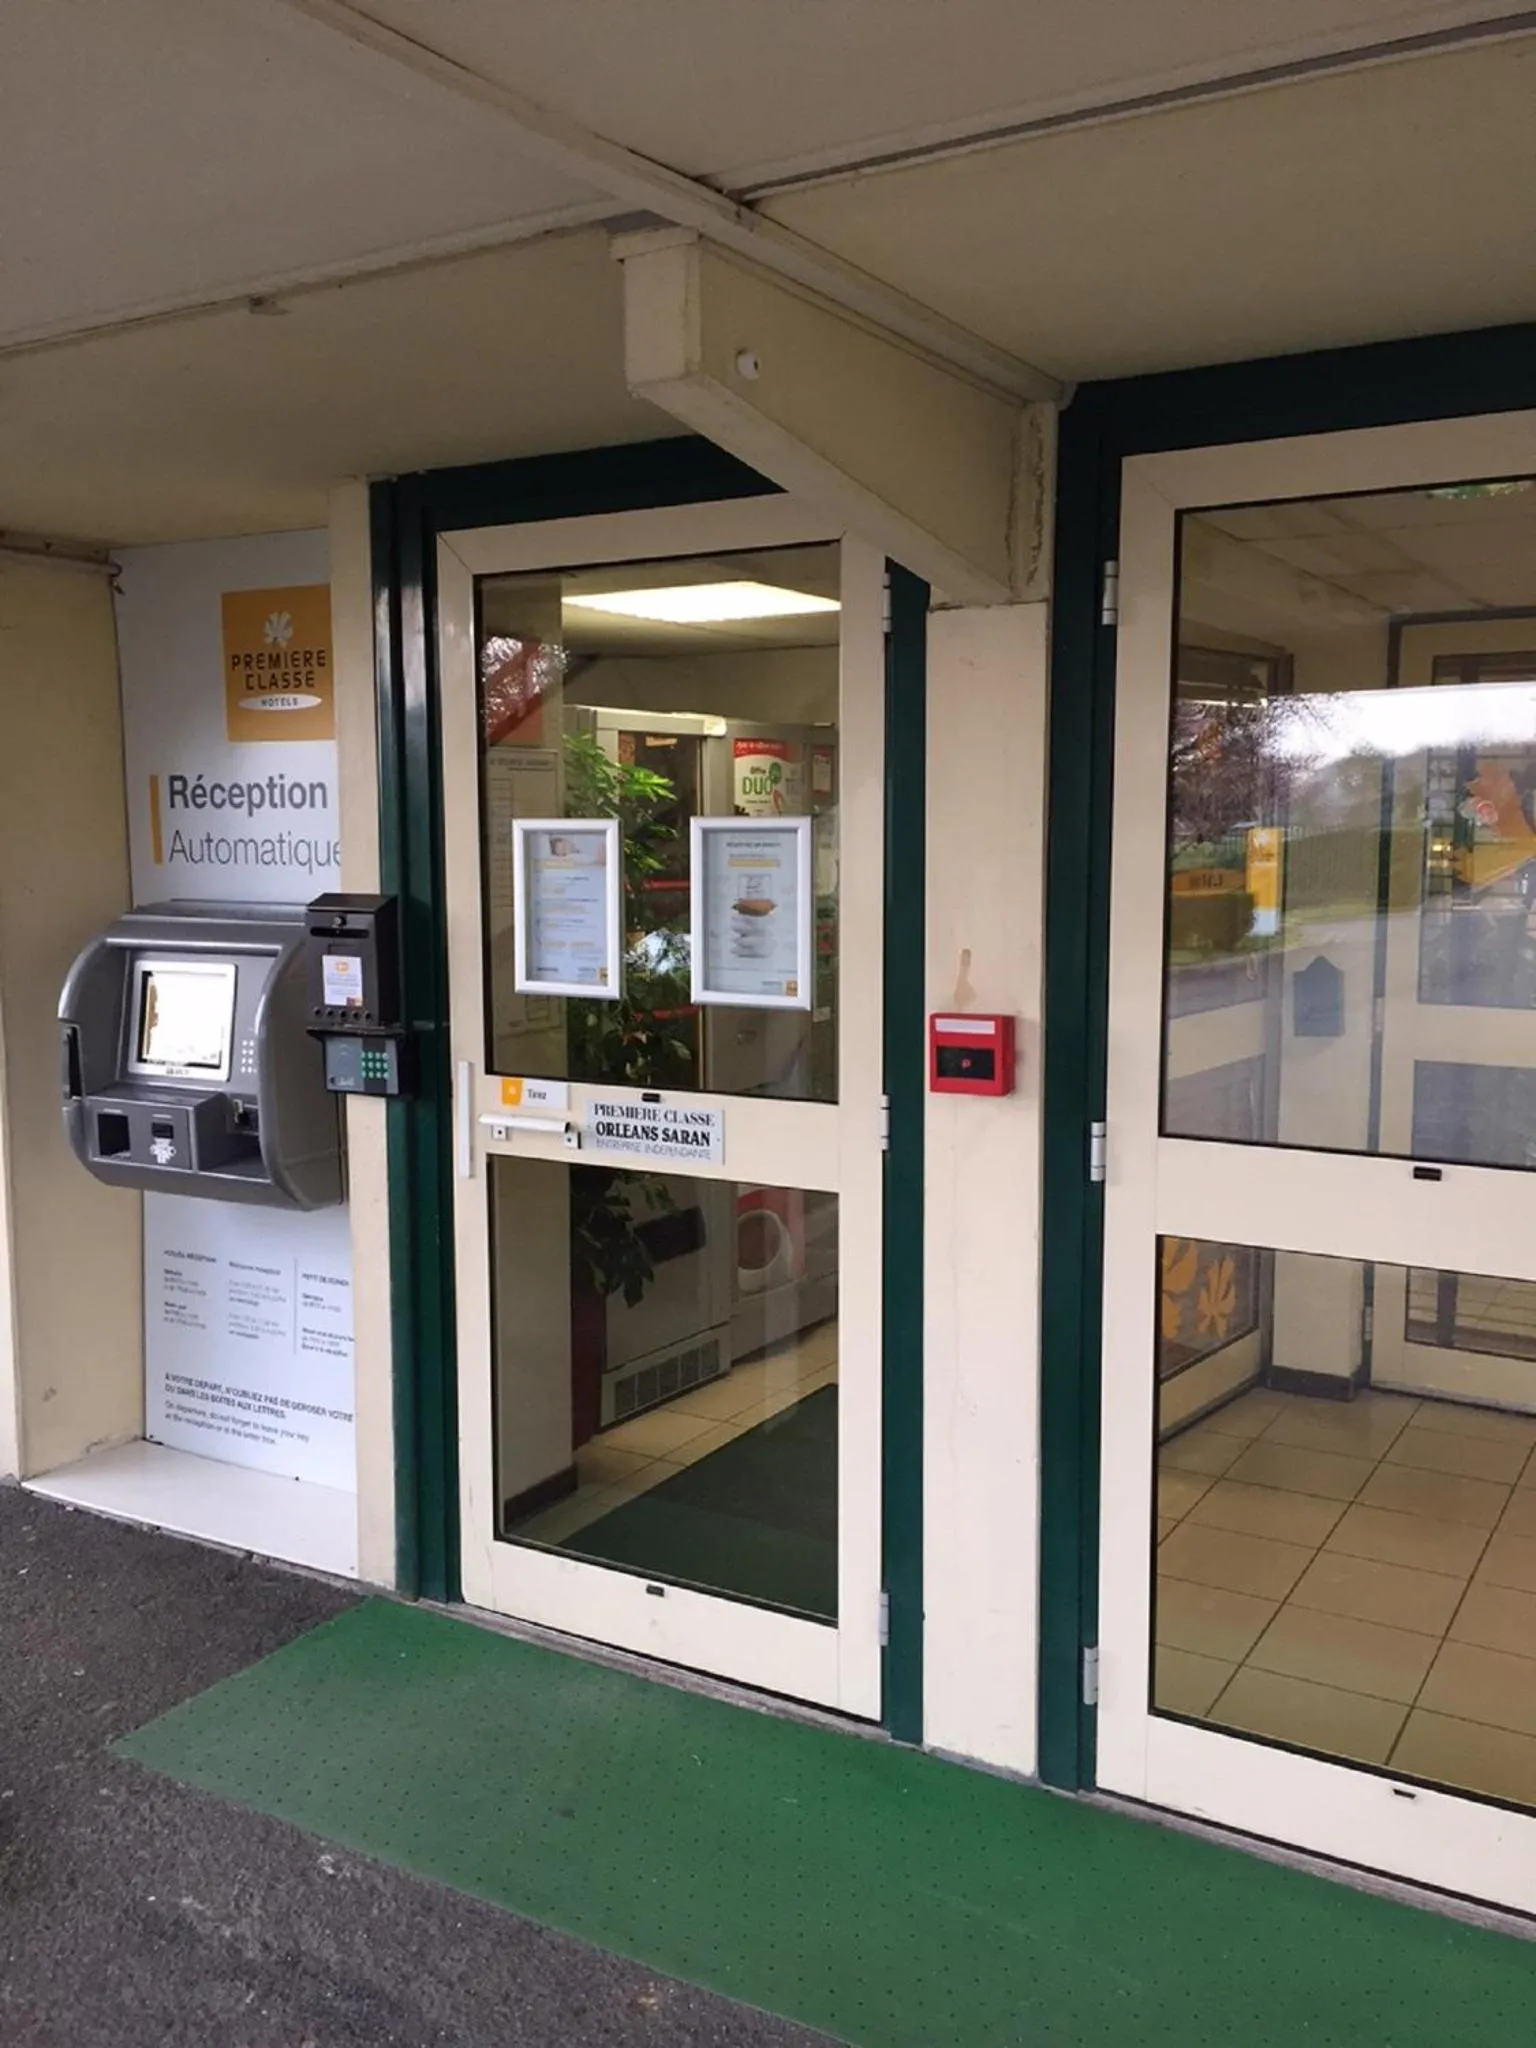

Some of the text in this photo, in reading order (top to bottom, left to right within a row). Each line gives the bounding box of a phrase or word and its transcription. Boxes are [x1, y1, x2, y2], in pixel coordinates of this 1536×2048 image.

[246, 671, 316, 690] CLASSE
[169, 774, 328, 816] Réception
[742, 776, 773, 795] DUO
[663, 1109, 716, 1126] CLASSE
[595, 1120, 710, 1147] ORLEANS SARAN
